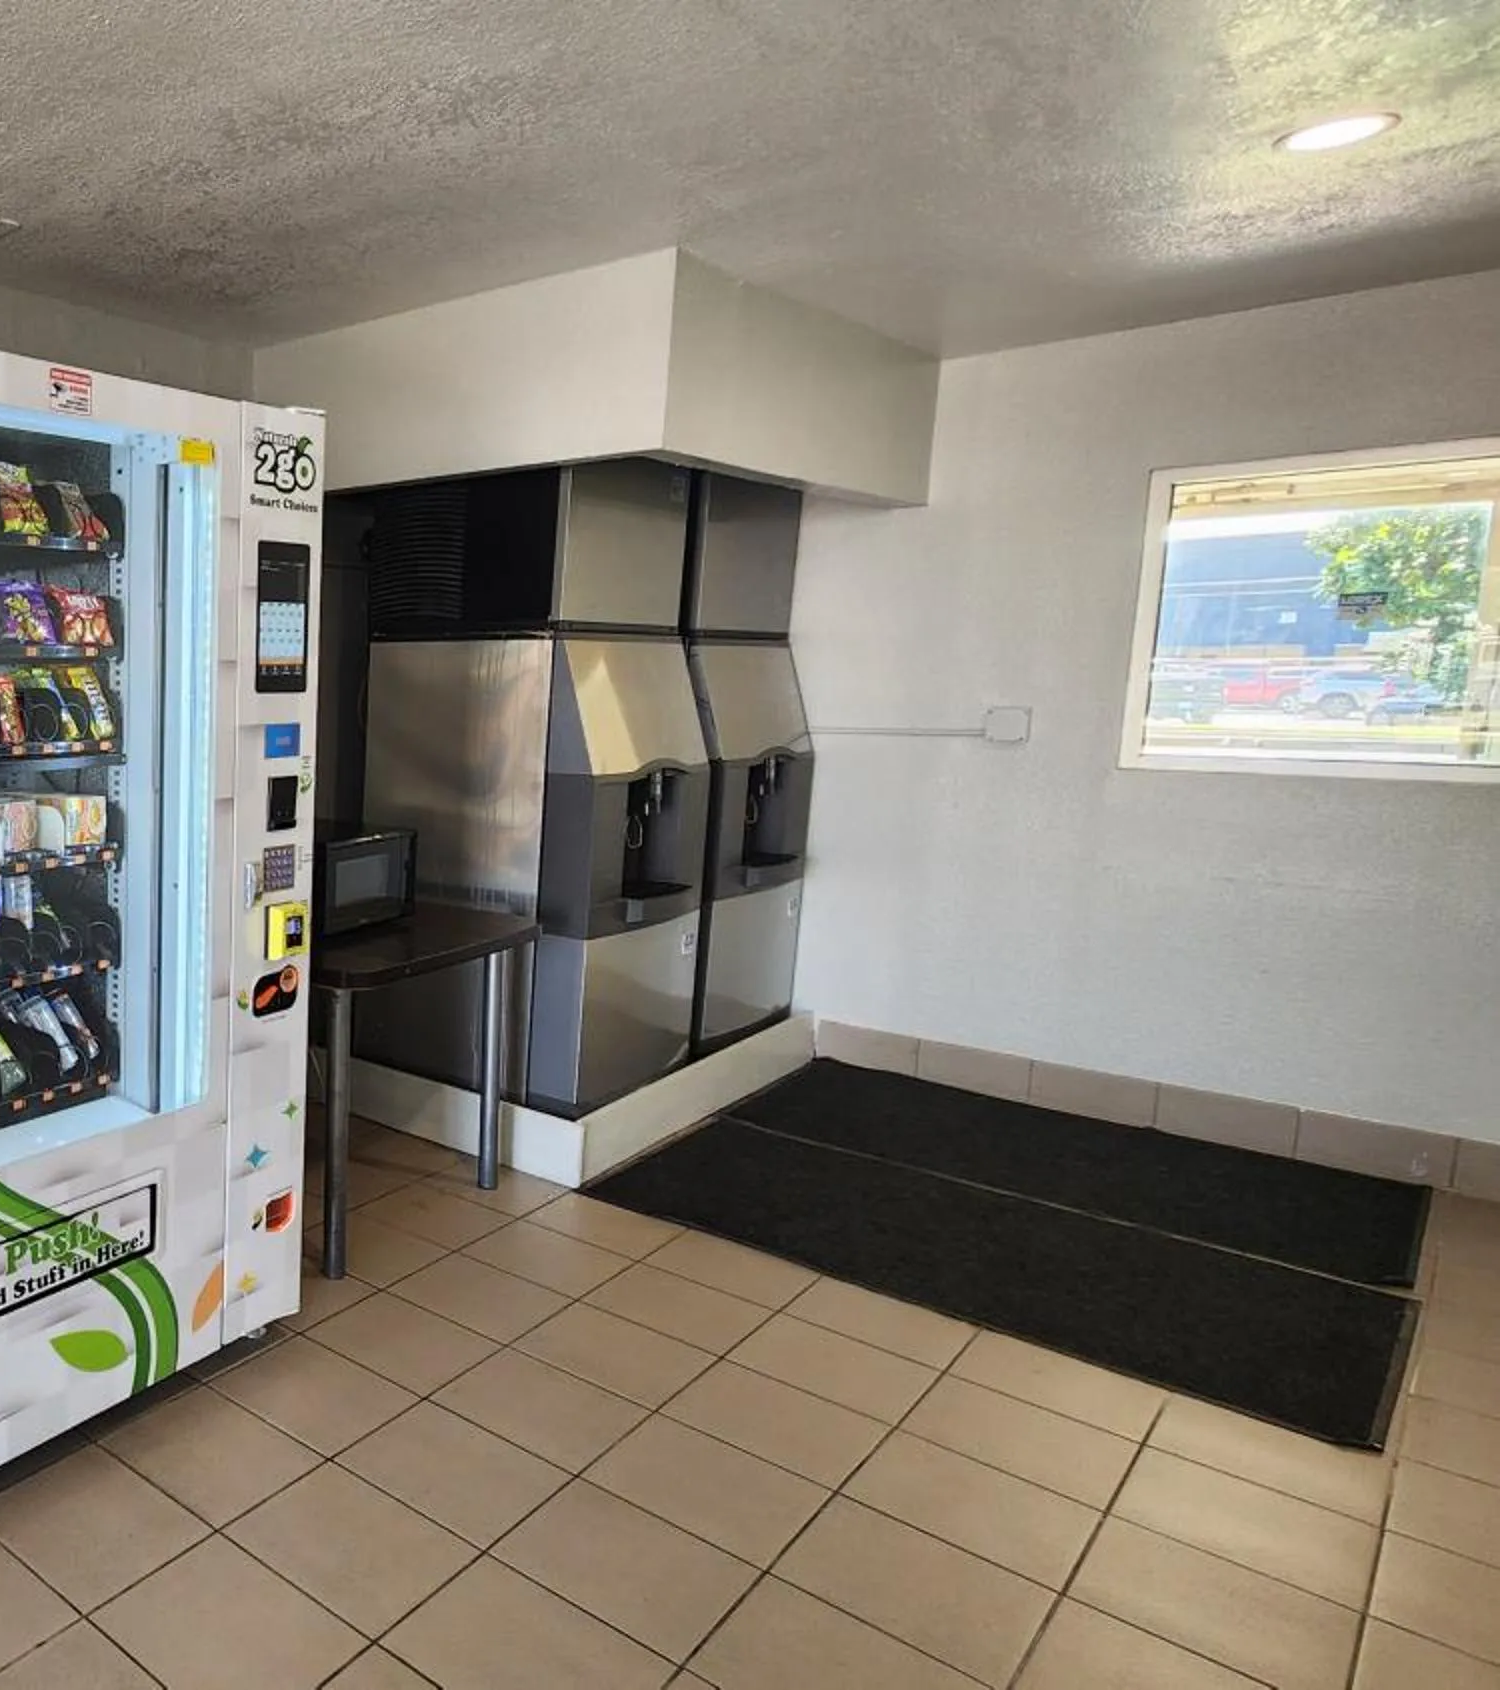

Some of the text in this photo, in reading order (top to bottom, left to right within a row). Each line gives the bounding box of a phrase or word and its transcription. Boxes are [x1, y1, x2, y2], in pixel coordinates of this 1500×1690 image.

[3, 1211, 100, 1277] Push!
[13, 1264, 67, 1299] Stuff
[72, 1254, 91, 1275] in
[97, 1230, 145, 1264] Here!
